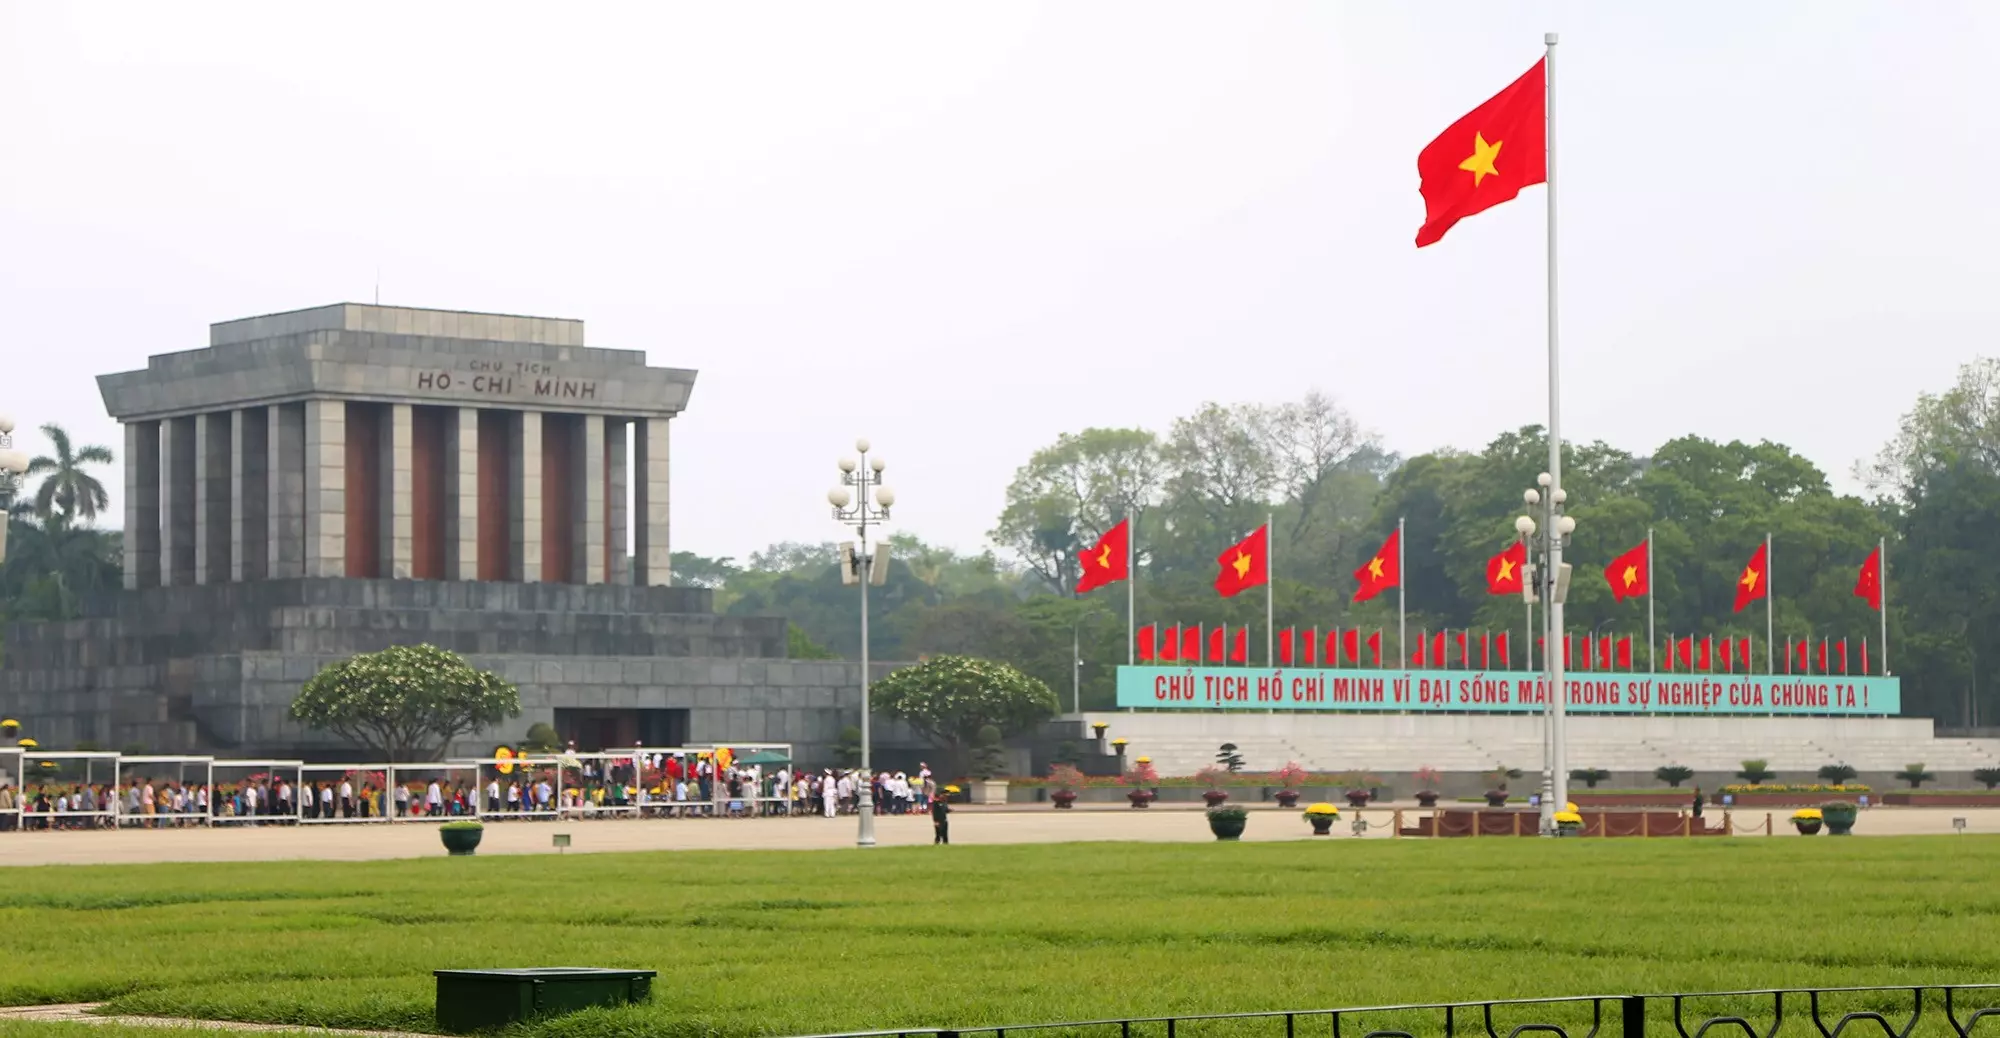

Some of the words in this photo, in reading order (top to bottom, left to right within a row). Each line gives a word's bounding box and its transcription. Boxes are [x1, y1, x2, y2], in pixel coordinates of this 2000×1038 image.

[1155, 668, 1194, 700] CHỦ
[1204, 676, 1248, 706] TỊCH
[1293, 672, 1324, 702] CHÍ
[1334, 678, 1384, 702] MINH
[1393, 673, 1411, 702] VĨ
[1419, 679, 1450, 708] ĐẠI
[1459, 673, 1509, 703] SỐNG
[1628, 680, 1652, 709] SỰ
[1658, 678, 1722, 709] NGHIỆP
[1730, 676, 1763, 706] CỦA
[1771, 679, 1828, 706] CHÚNG
[1836, 684, 1855, 707] TA
